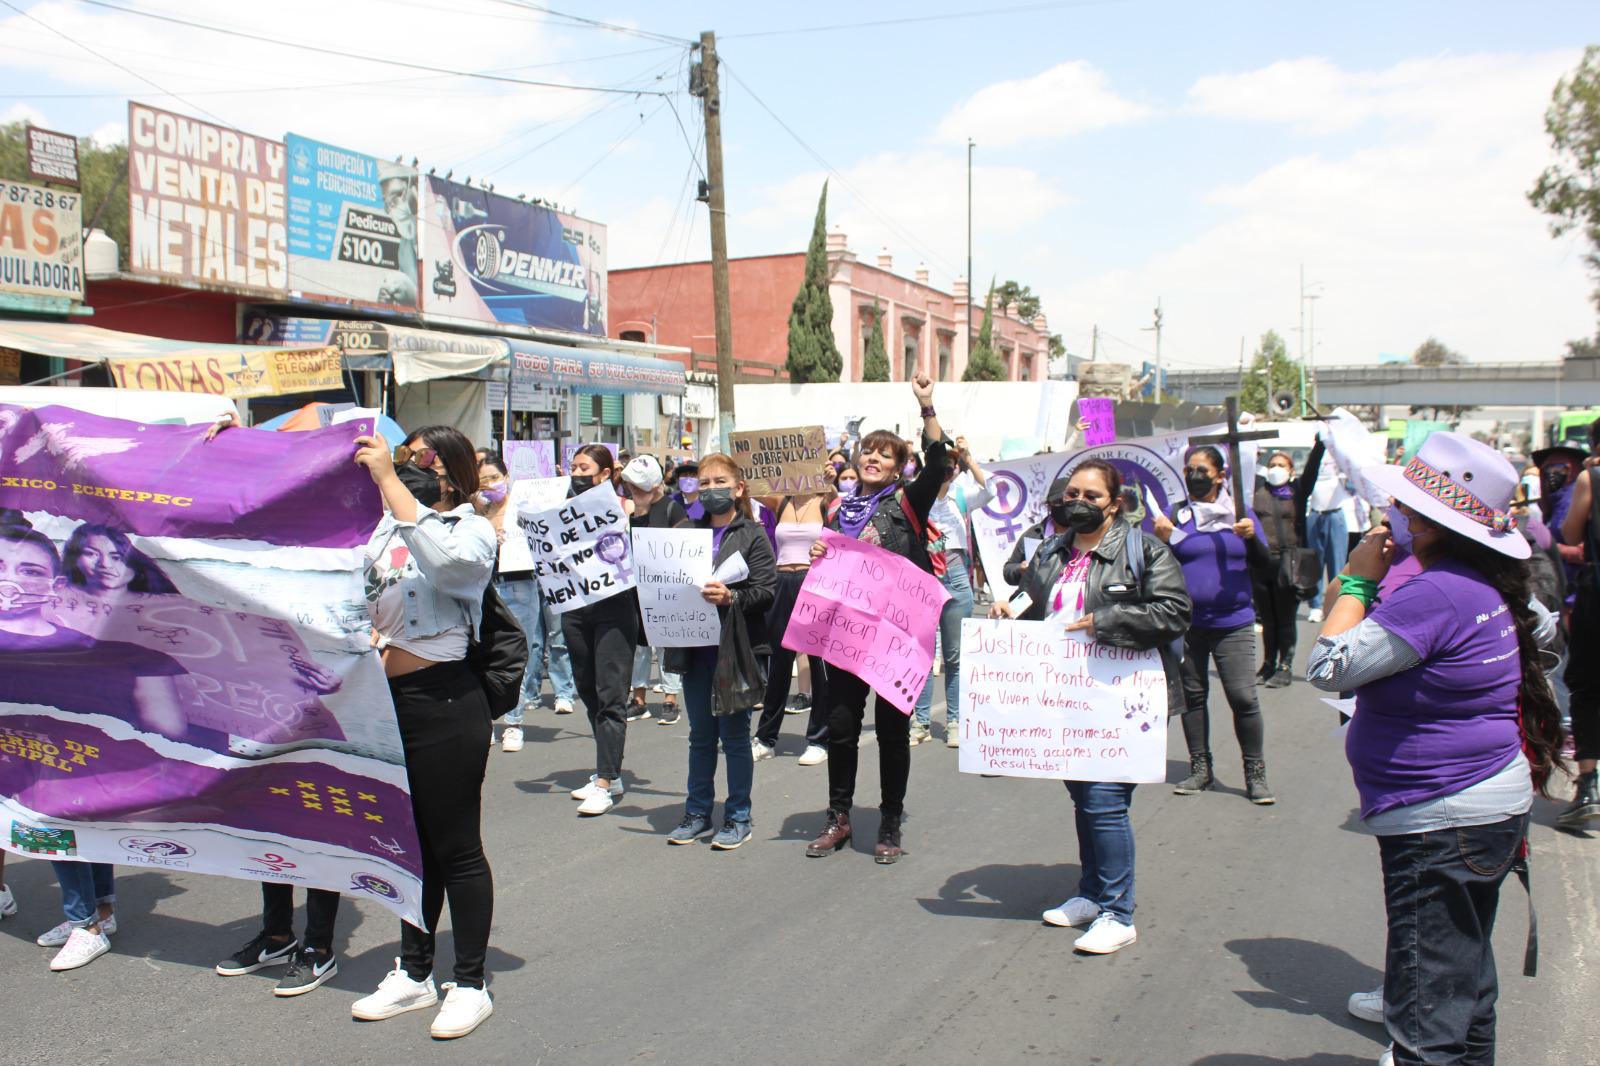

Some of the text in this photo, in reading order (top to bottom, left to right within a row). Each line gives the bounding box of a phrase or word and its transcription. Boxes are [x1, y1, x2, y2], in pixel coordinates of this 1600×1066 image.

[133, 106, 259, 174] COMPRA
[265, 142, 285, 180] Y
[317, 146, 374, 179] ORTOPEDÍA Y
[134, 151, 239, 210] VENTA
[245, 177, 285, 220] DE
[317, 170, 377, 201] PEDICURISTAS
[348, 212, 396, 234] Pedicure
[130, 193, 288, 290] METALES
[342, 237, 383, 265] $100
[0, 255, 81, 292] UILADORA
[500, 249, 588, 289] DENMIR
[338, 320, 374, 330] Pedicure
[336, 332, 371, 348] $100
[276, 359, 340, 375] ELEGANTES
[514, 352, 549, 372] TODO
[552, 357, 583, 375] PARA
[588, 361, 603, 378] SU
[734, 433, 804, 453] NO QUIERO
[752, 447, 819, 465] SOBREVIVIR
[0, 477, 57, 490] XICO
[72, 483, 192, 507] ECATEPEC
[767, 474, 826, 492] VIVIR
[558, 506, 585, 525] EL
[560, 527, 580, 545] DE
[583, 509, 619, 534] LAS
[547, 561, 570, 574] YA
[571, 548, 594, 566] NO
[860, 559, 885, 582] NO
[578, 572, 615, 596] VOZ
[638, 565, 694, 586] Homicidio
[968, 626, 1055, 657] Justicia
[968, 691, 991, 713] que
[998, 727, 1053, 745] queremos
[64, 739, 100, 759] DE
[978, 743, 1037, 761] queremos
[1100, 746, 1129, 759] con
